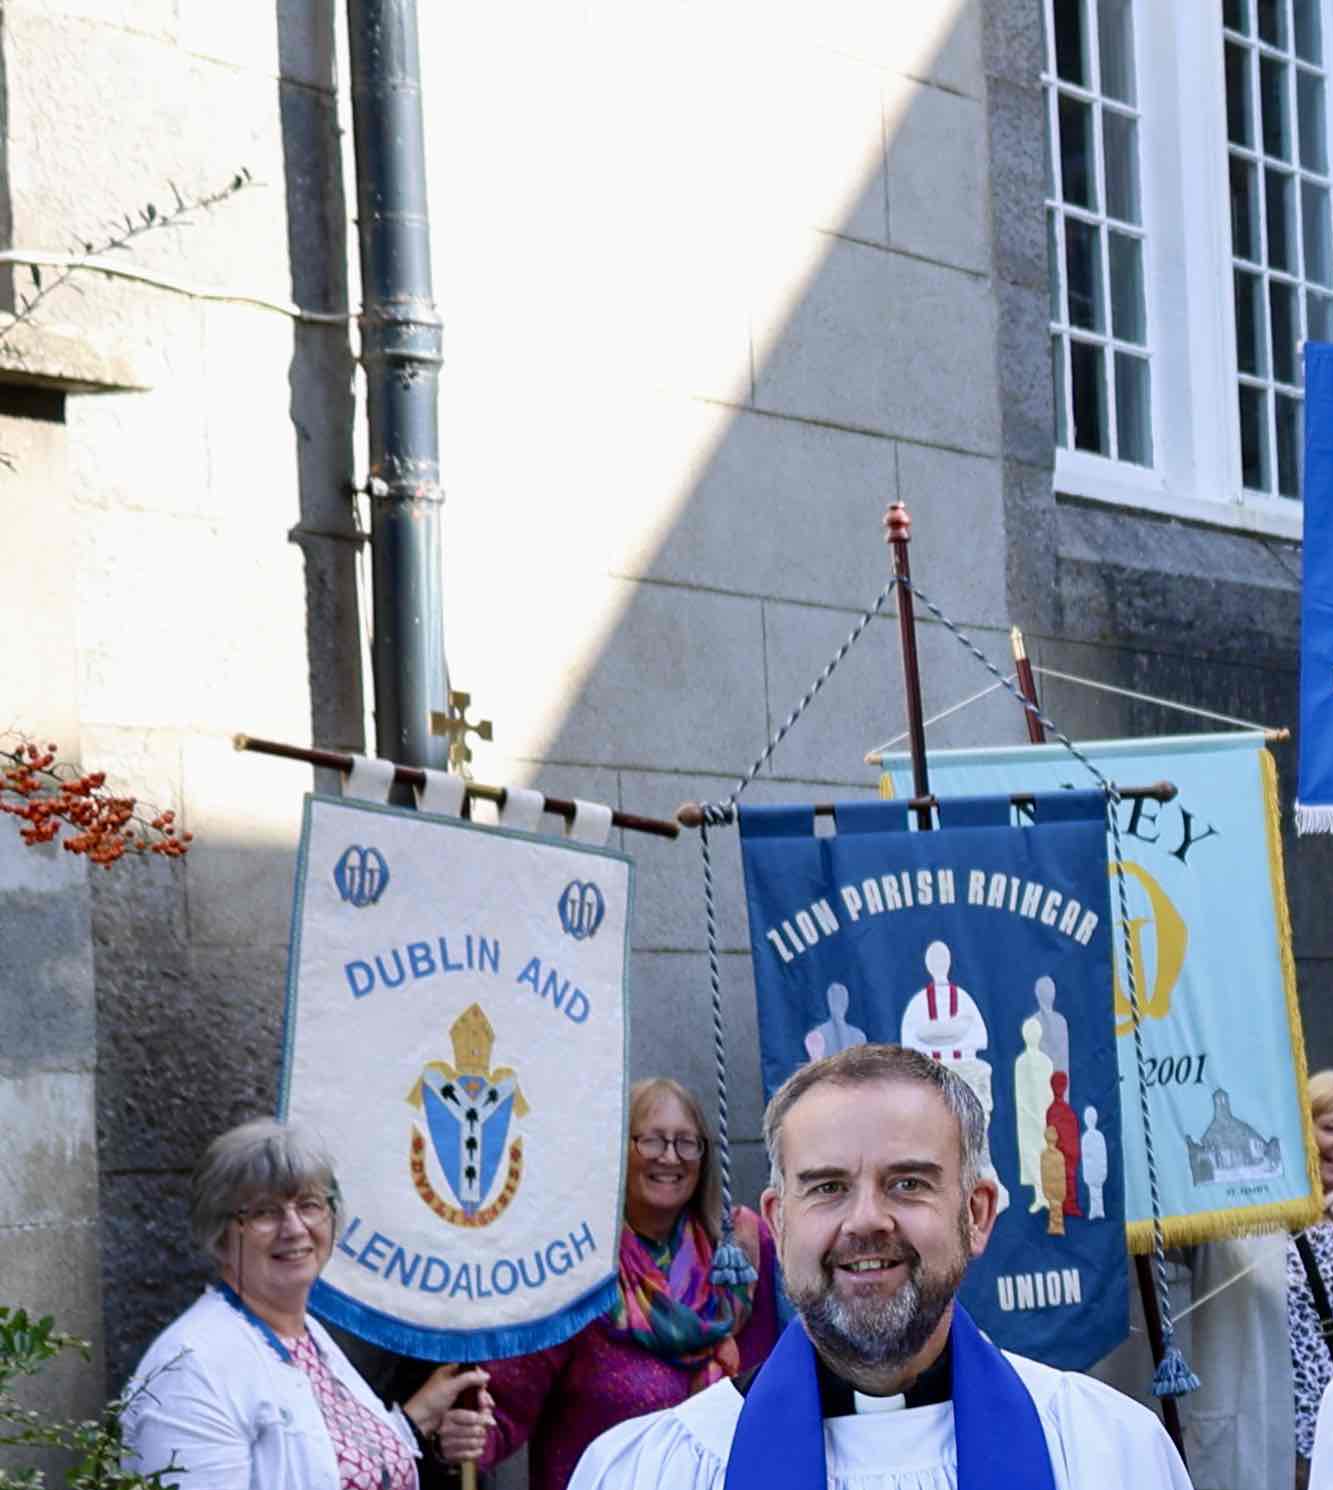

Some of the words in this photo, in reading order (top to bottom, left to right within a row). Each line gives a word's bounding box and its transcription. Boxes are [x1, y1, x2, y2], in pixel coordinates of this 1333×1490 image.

[766, 898, 840, 963] ZION
[840, 869, 955, 921] PARISH
[968, 869, 1099, 946] RATHGAR
[344, 934, 500, 1000] DUBLIN
[516, 956, 590, 1024] AND
[1144, 1053, 1208, 1087] 2001
[335, 1215, 597, 1300] LENDALOUGH
[997, 1268, 1081, 1312] UNION
